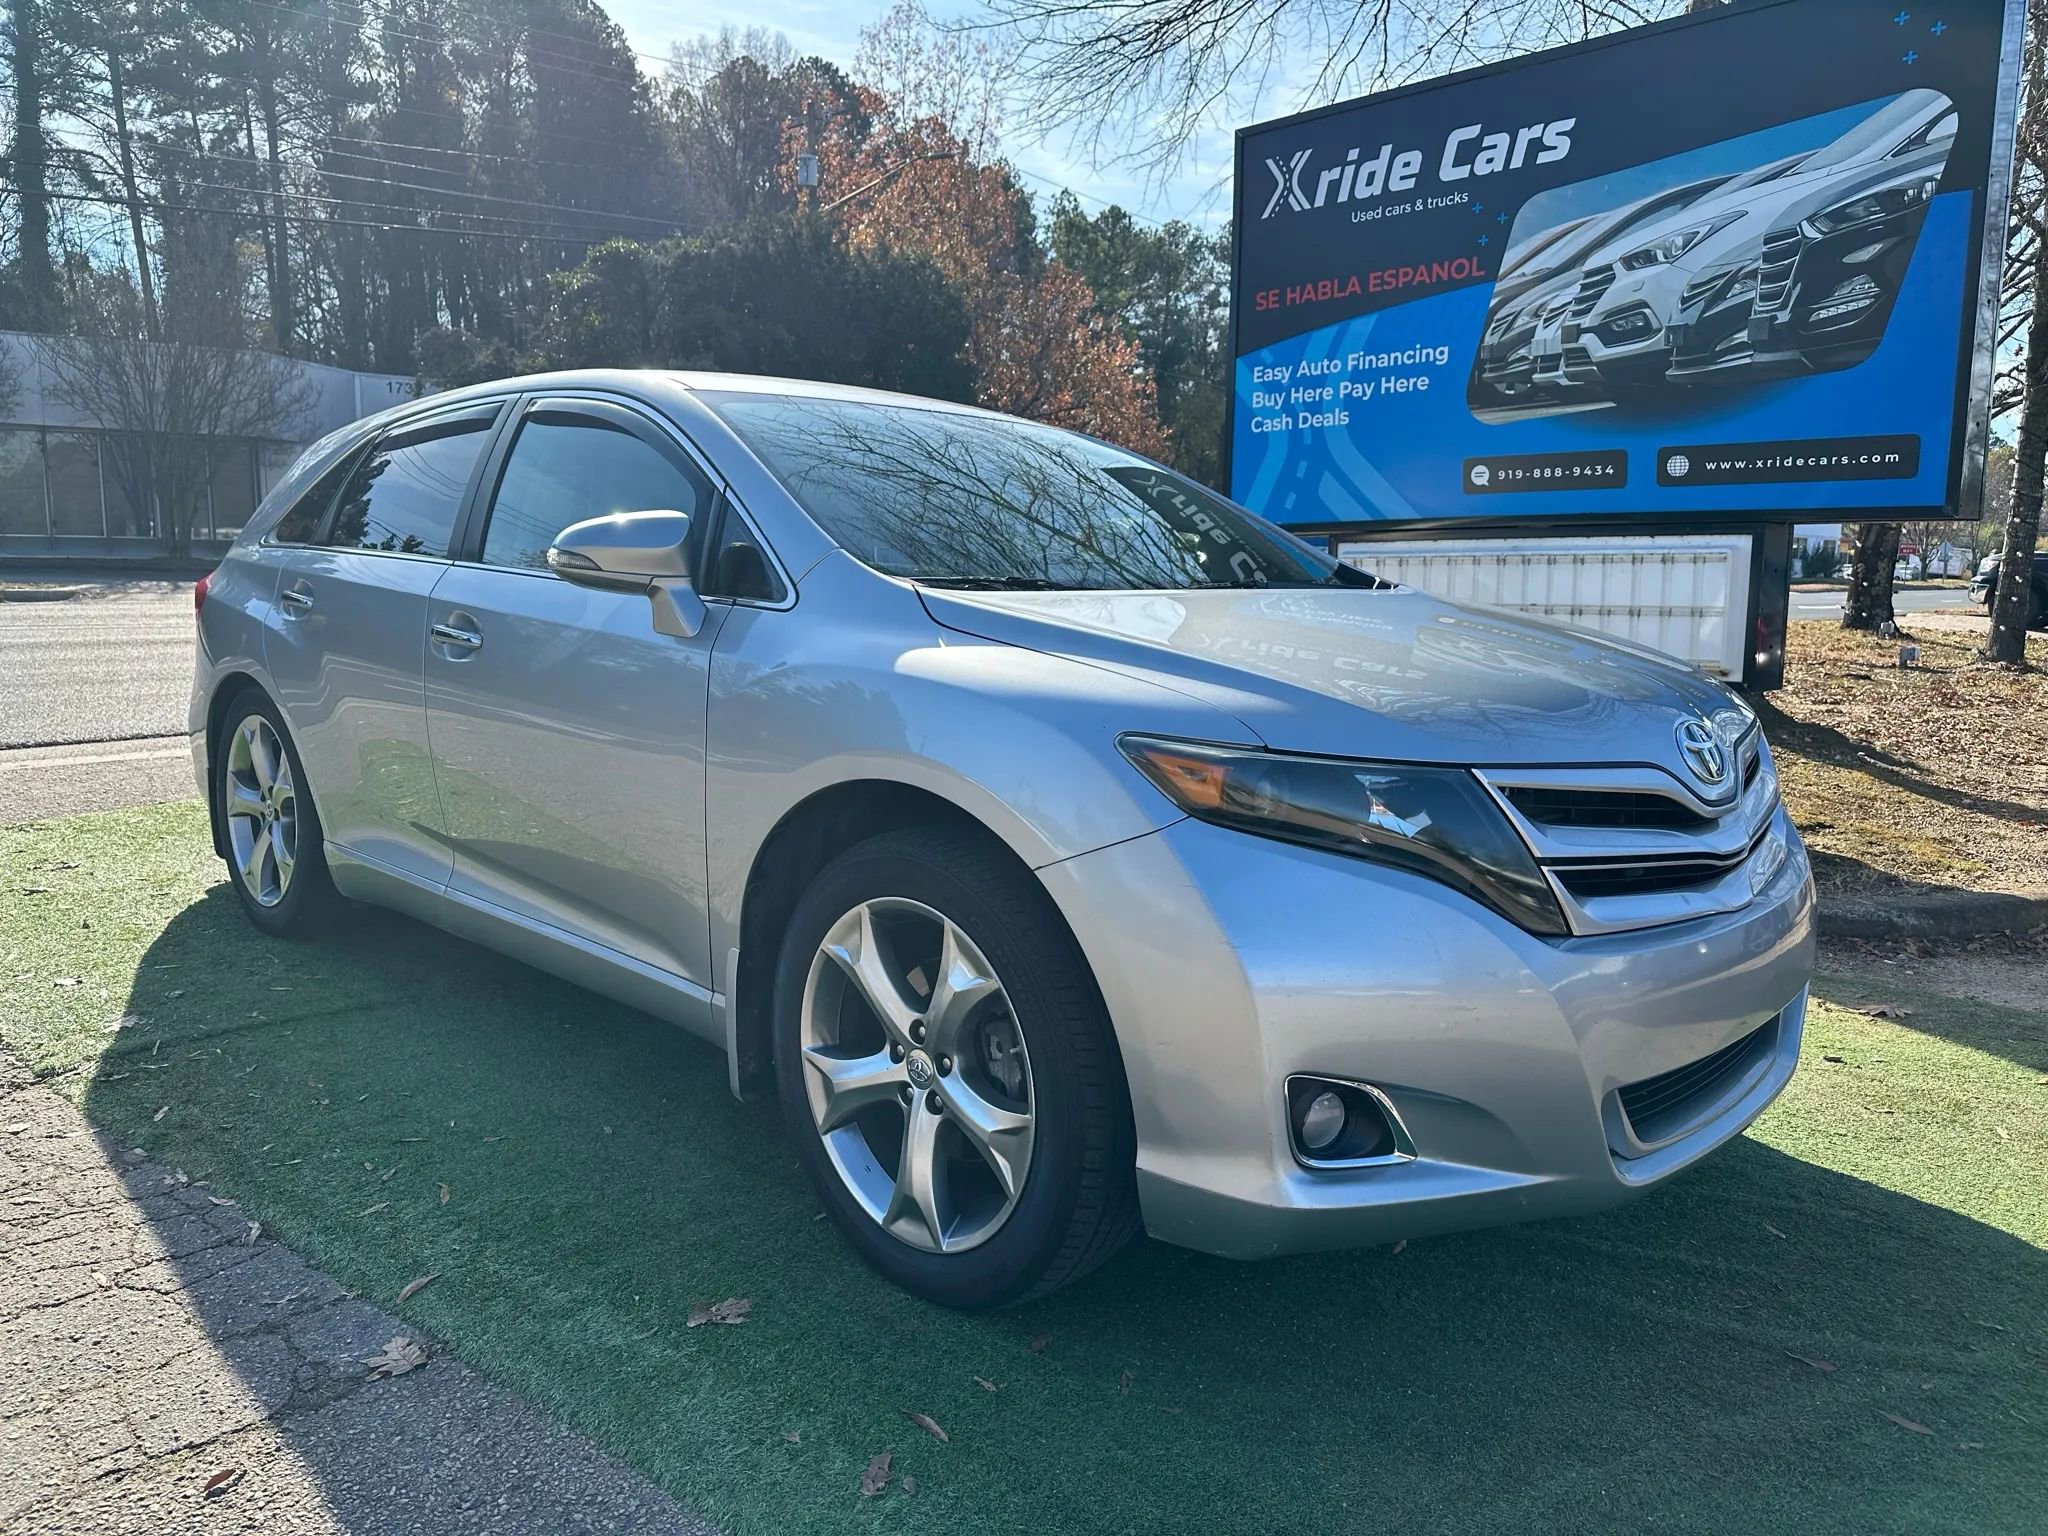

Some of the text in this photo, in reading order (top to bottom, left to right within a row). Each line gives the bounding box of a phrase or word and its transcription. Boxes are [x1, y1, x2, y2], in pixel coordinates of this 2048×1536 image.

[1261, 117, 1576, 219] Xride Cars
[1351, 191, 1469, 223] Used cars & trucks
[1255, 256, 1486, 311] SE HABLA ESPANOL
[1253, 343, 1449, 384] Easy Auto Financing
[1252, 375, 1429, 410] Buy Here Pay Here
[1251, 408, 1350, 433] Cash Deals
[1498, 464, 1615, 480] 919-888-9434
[1705, 451, 1900, 470] www.xridecars.com
